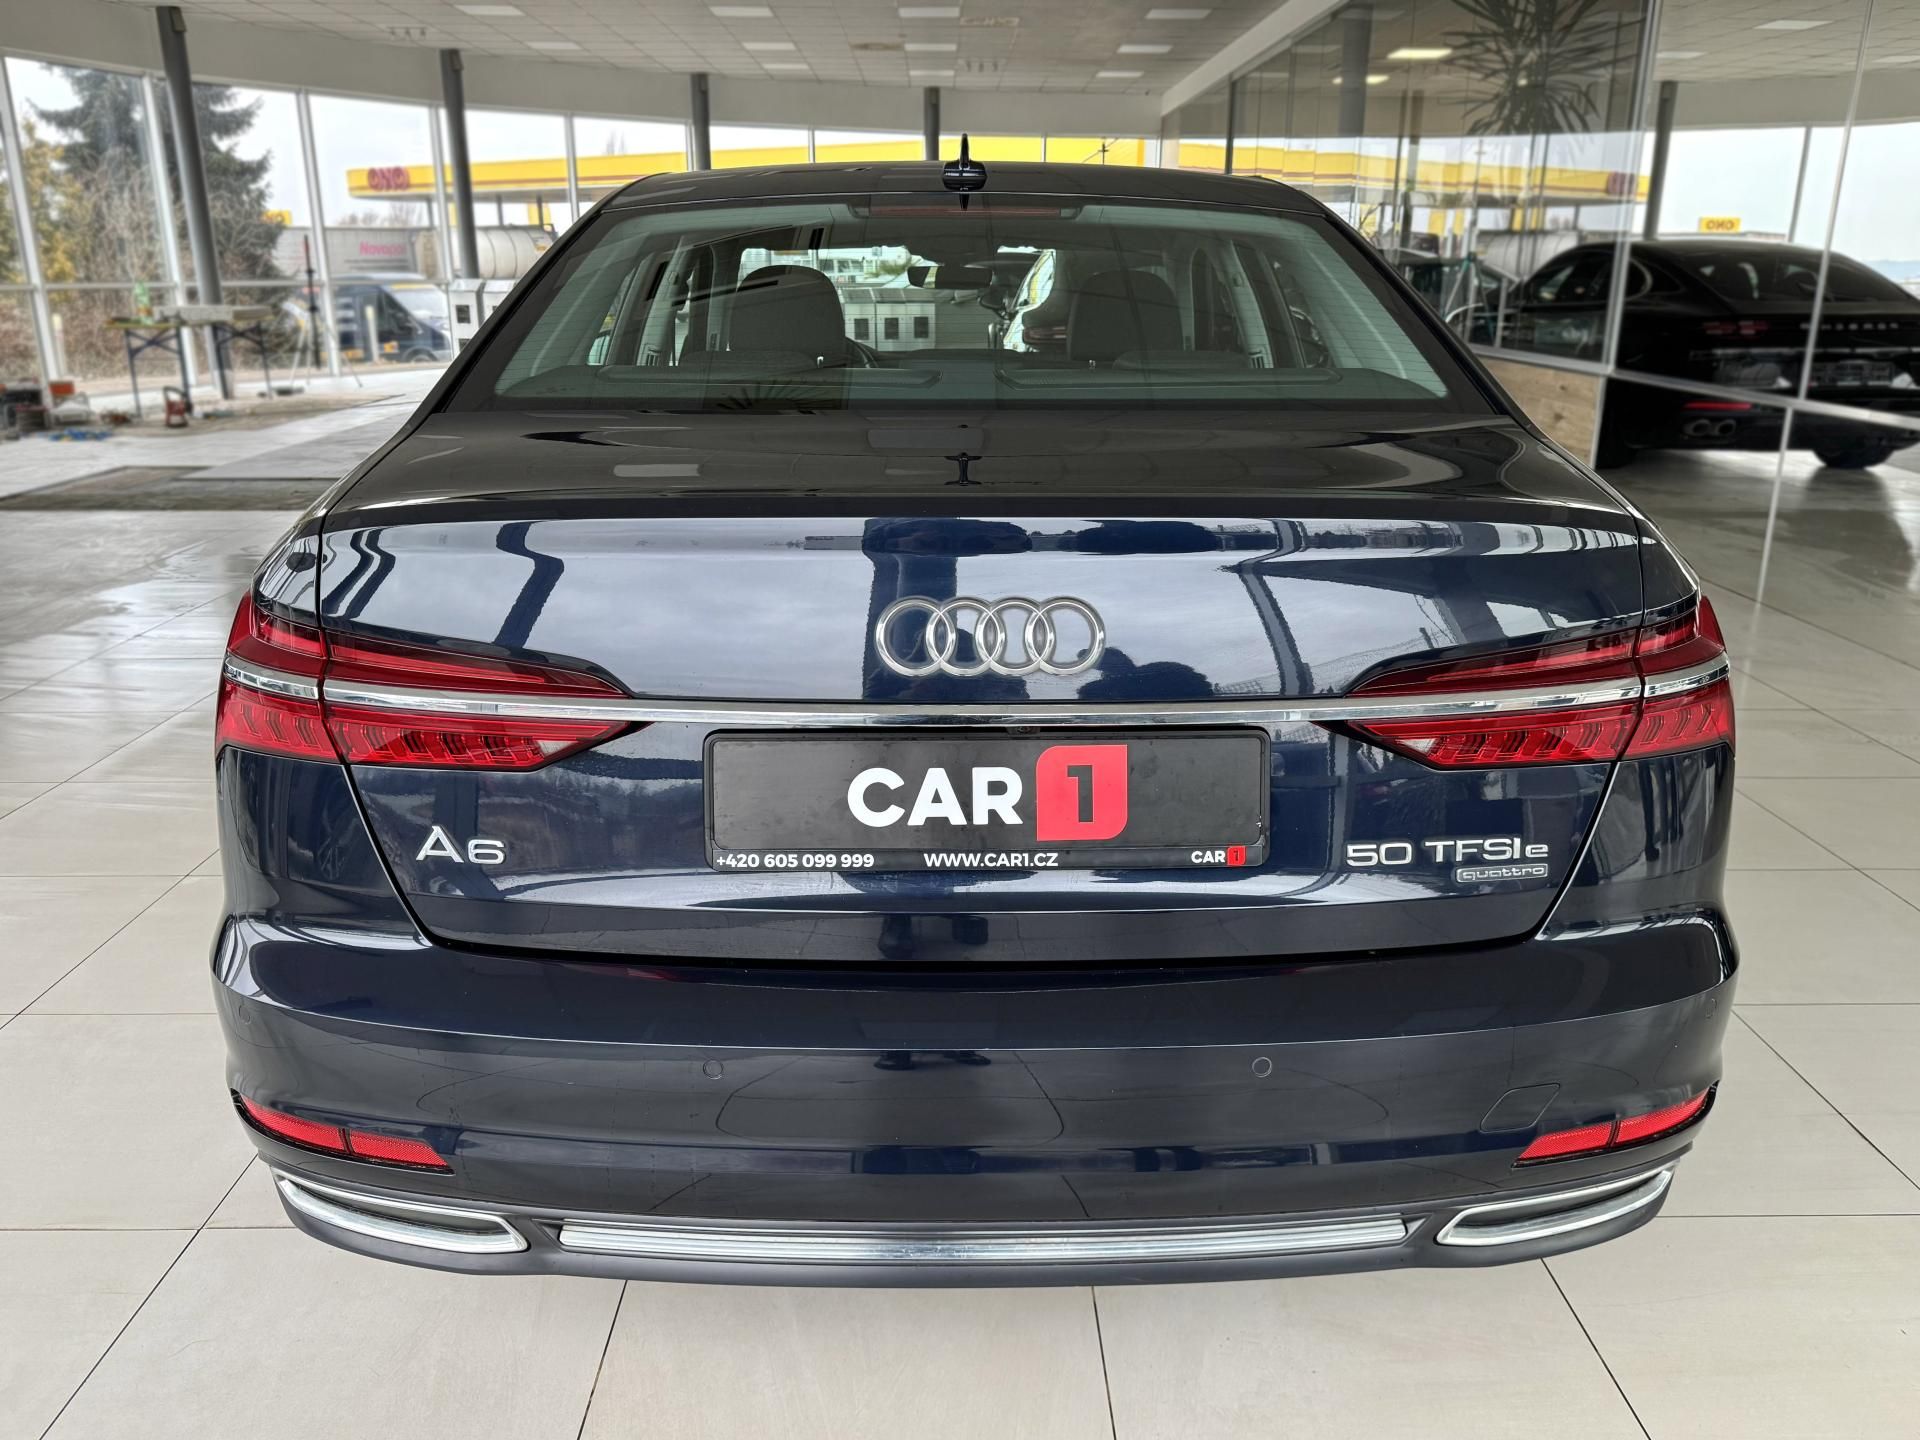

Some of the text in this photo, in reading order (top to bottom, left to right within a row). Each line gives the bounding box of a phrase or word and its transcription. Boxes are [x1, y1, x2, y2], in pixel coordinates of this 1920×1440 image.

[847, 767, 1024, 827] CAR
[415, 825, 505, 865] A6
[716, 853, 875, 868] +420 605 099 999
[923, 852, 1059, 867] WWW.CAR1.CZ
[1191, 850, 1226, 864] CAR
[1346, 841, 1413, 867] 50
[1461, 866, 1546, 882] quattro
